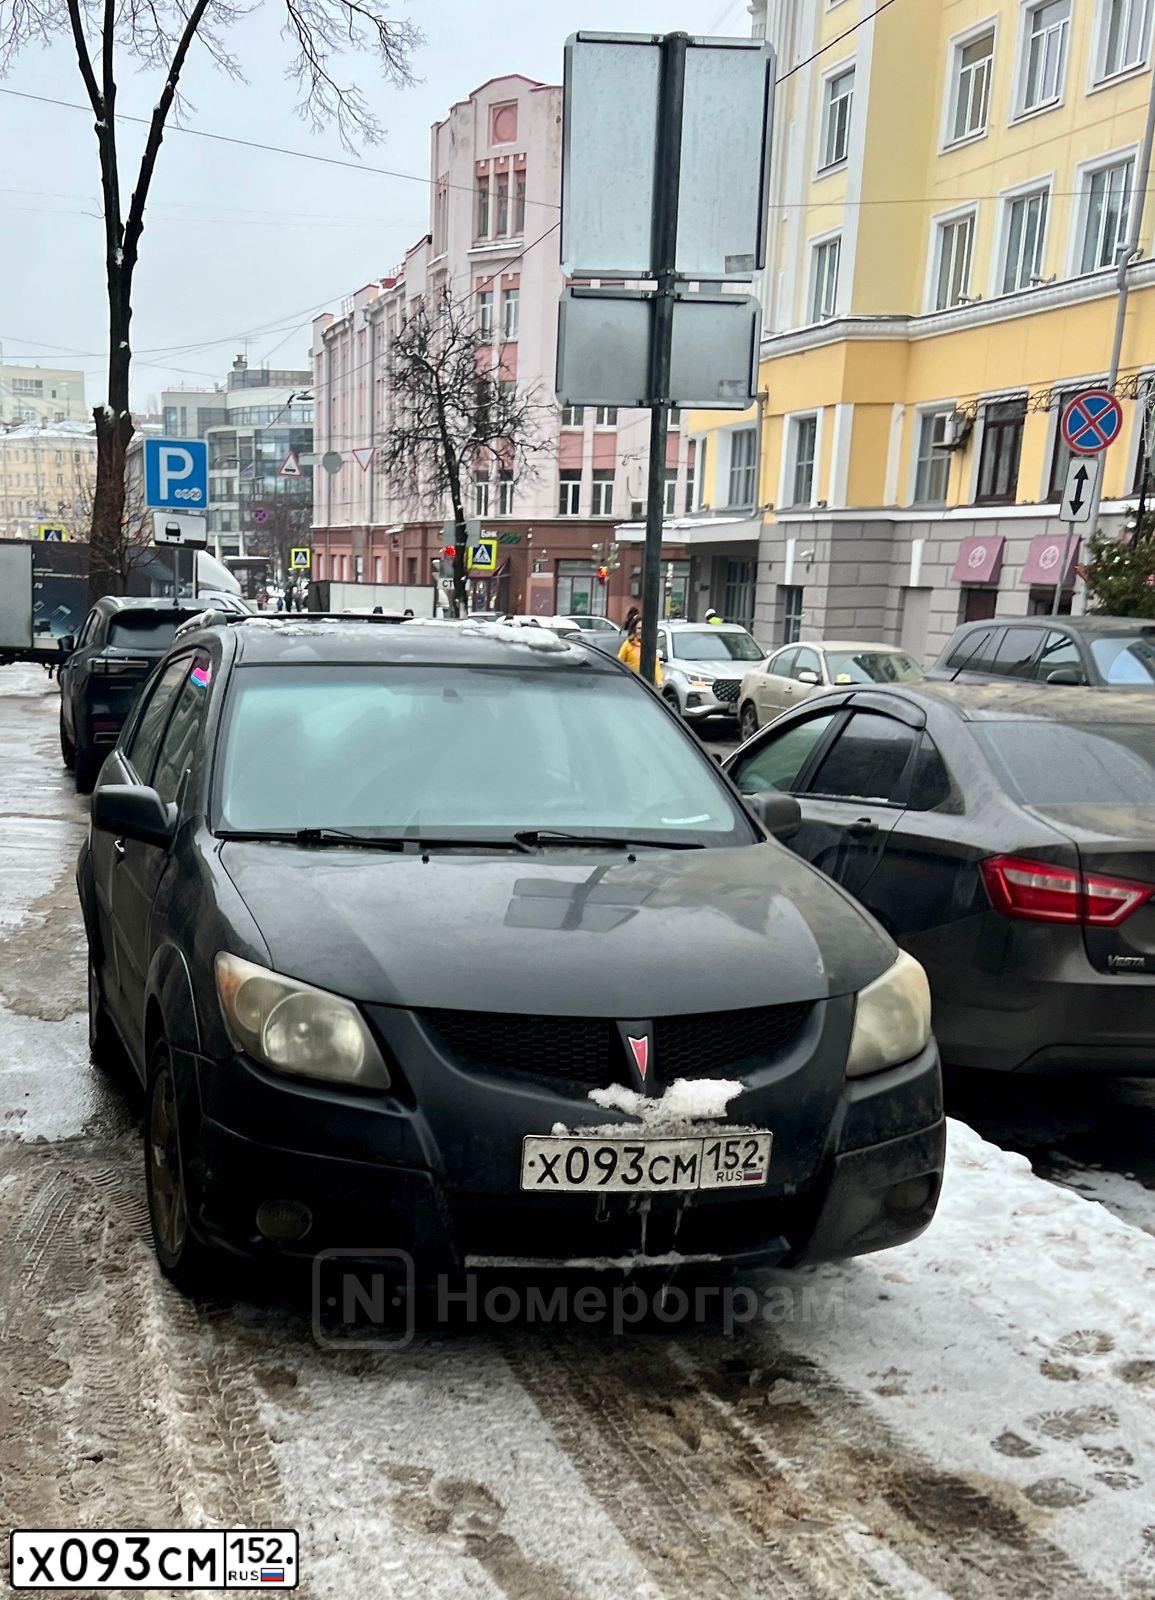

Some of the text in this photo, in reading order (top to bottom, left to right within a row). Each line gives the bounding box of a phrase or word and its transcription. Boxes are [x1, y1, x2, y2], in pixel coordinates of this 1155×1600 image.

[158, 446, 194, 500] P
[536, 1139, 760, 1185] Х093СМ 152
[716, 1170, 743, 1182] RUS
